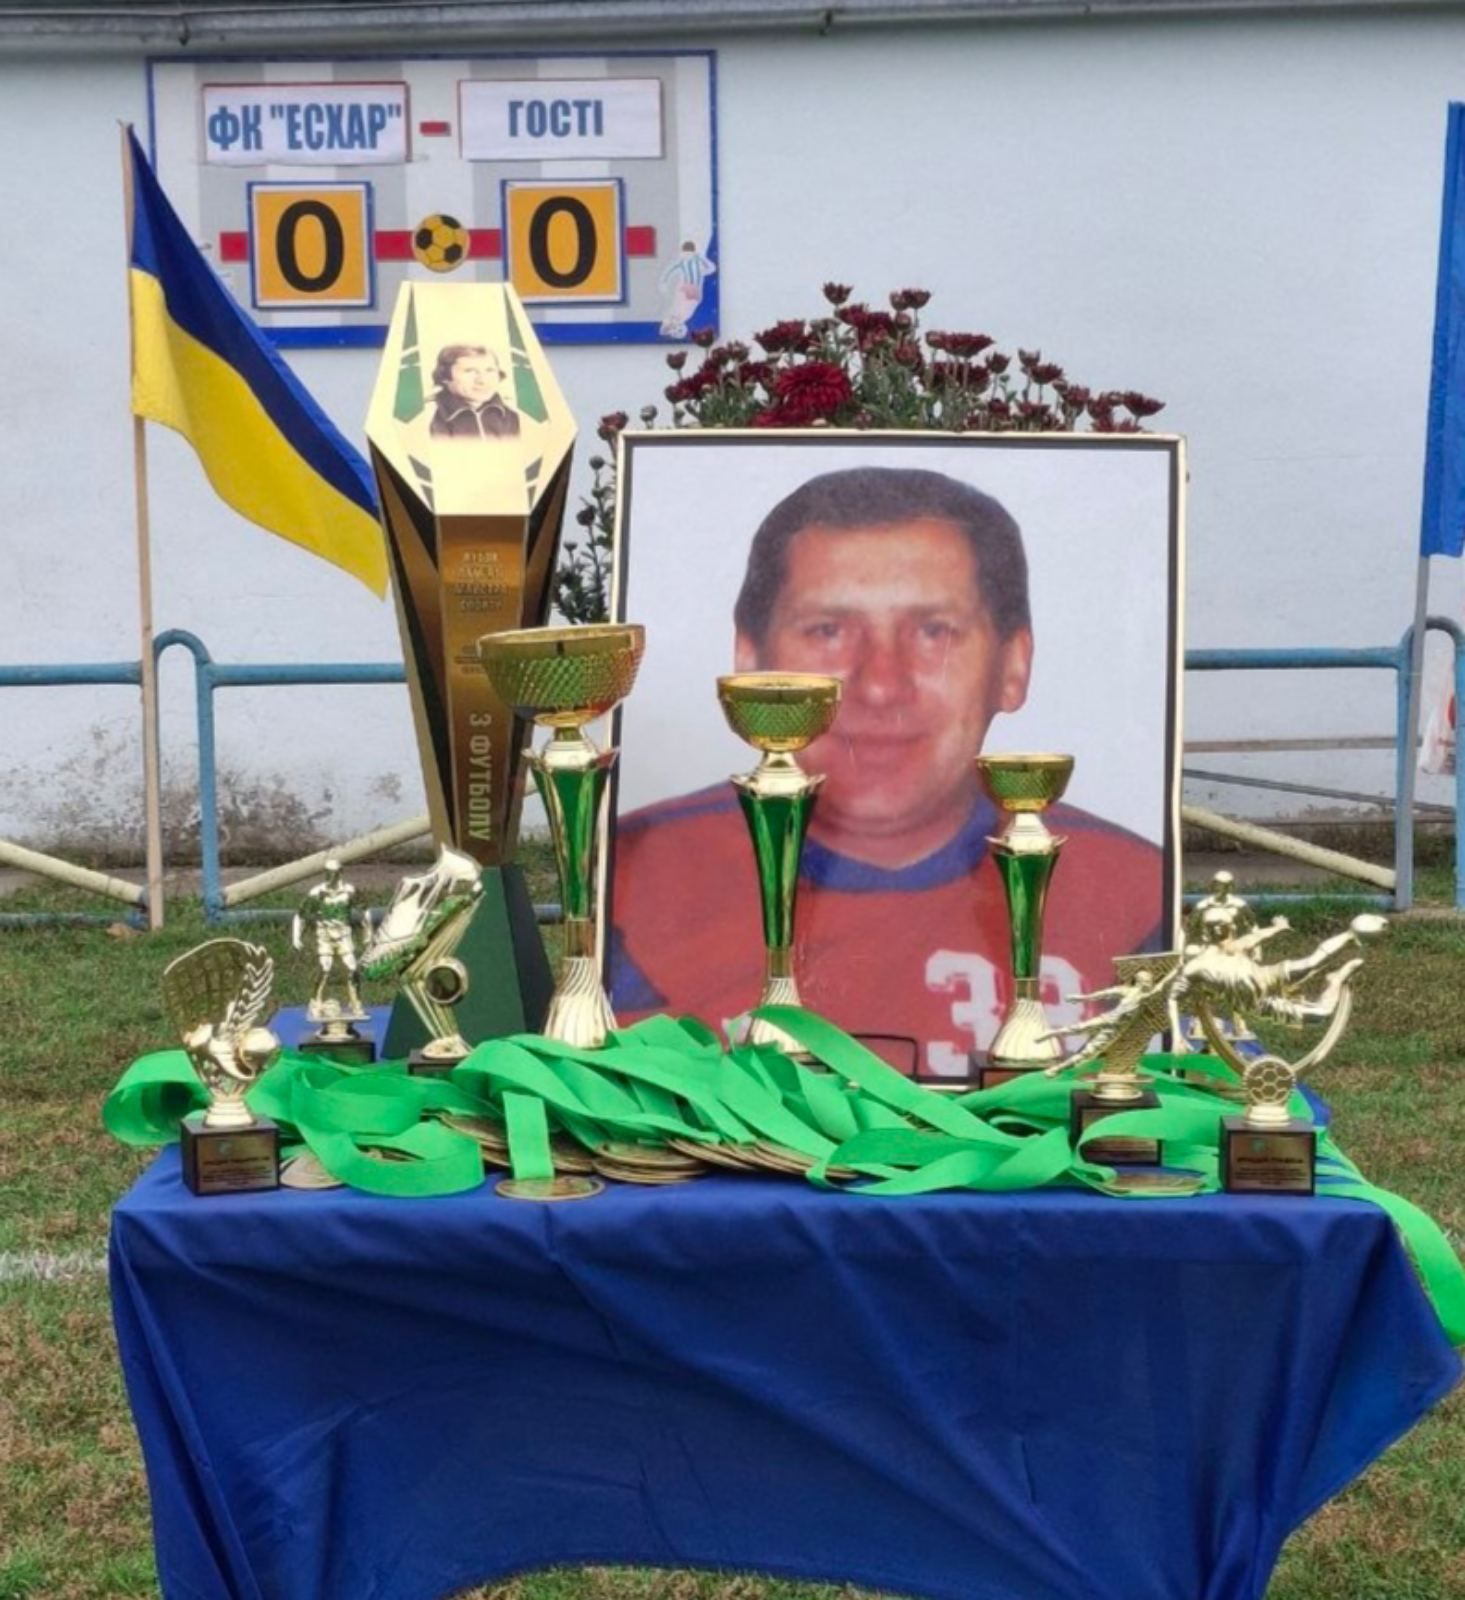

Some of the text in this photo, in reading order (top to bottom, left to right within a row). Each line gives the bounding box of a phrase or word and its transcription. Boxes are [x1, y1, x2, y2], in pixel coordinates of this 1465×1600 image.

[208, 103, 402, 151] ФК "ЕСХАР"
[508, 99, 604, 137] ГОСТІ
[275, 200, 345, 293] 0
[529, 196, 597, 288] 0
[468, 735, 492, 841] ФУТБОЛУ
